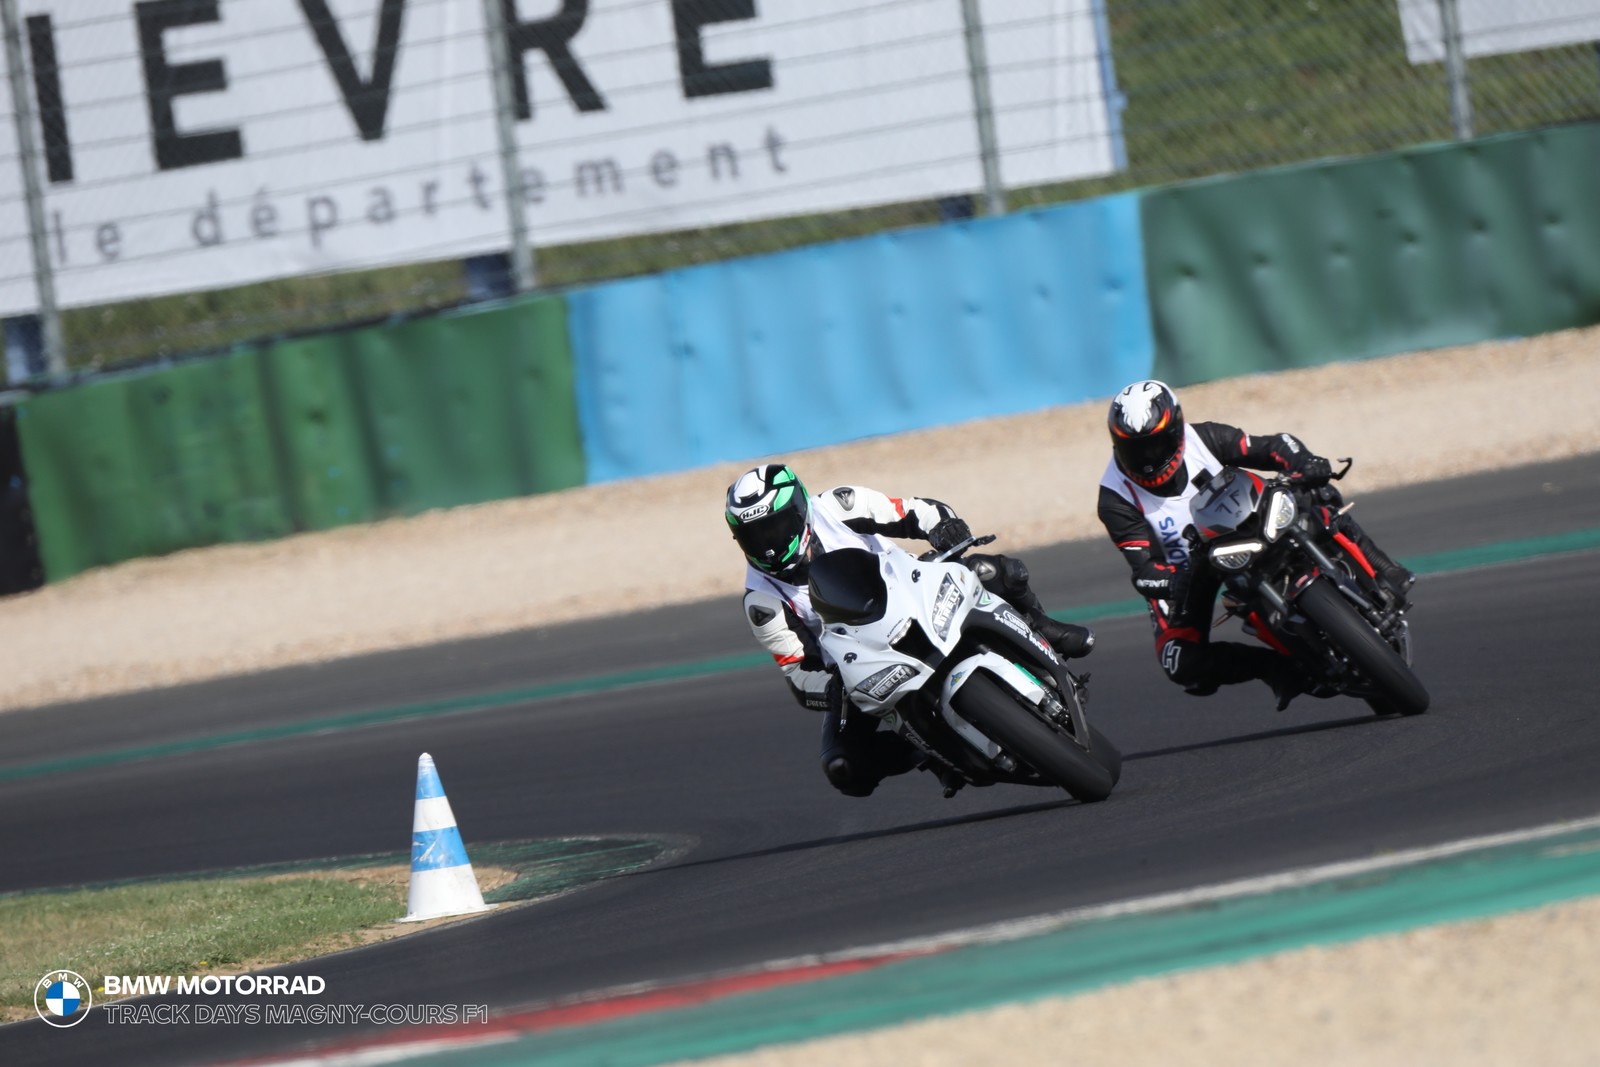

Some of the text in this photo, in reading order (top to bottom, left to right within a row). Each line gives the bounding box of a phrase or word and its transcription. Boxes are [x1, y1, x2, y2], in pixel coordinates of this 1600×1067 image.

[53, 125, 789, 263] le département
[742, 504, 766, 519] HJC
[933, 583, 960, 627] PIRELLI
[868, 664, 908, 698] PIRELLI
